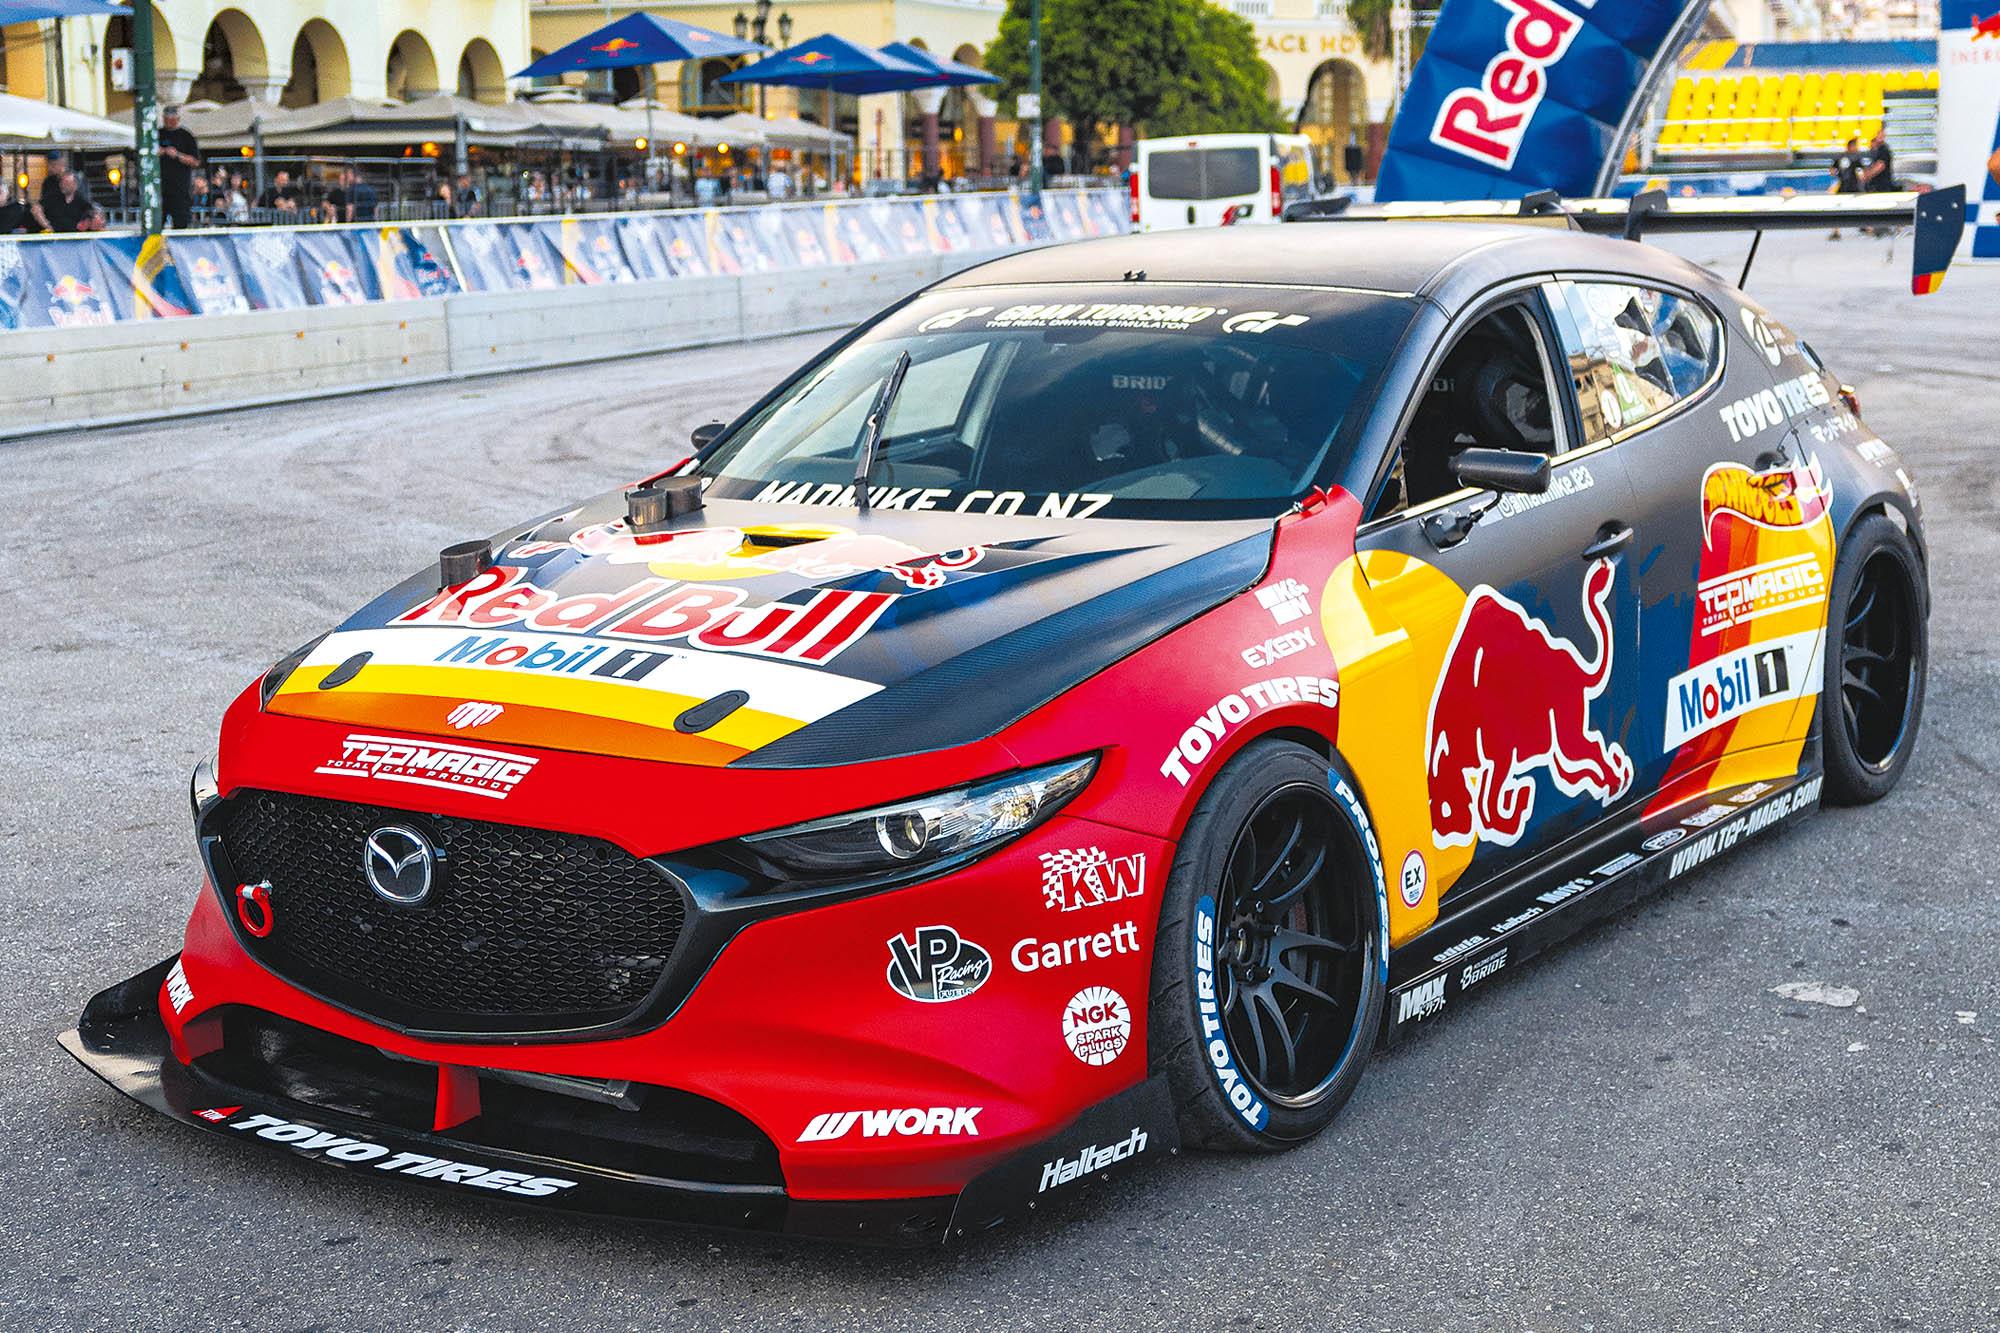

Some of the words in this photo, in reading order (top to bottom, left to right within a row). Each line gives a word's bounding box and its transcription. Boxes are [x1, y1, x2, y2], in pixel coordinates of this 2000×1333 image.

[1434, 0, 1578, 166] Red
[986, 320, 1010, 328] THE
[1012, 319, 1047, 328] REAL
[1049, 319, 1105, 328] DRIVING
[1107, 319, 1190, 330] SIMULATOR
[994, 304, 1085, 321] GRAN
[1719, 388, 1785, 443] TOYO
[1773, 372, 1831, 417] TIRES
[396, 566, 665, 628] Red
[610, 589, 892, 660] Bull
[433, 635, 610, 673] Mobil
[1240, 626, 1317, 669] EXEDY
[1678, 657, 1751, 732] Mobil
[1159, 694, 1251, 787] TOYO
[1240, 676, 1340, 709] TIRES
[326, 759, 369, 770] TOTAL
[382, 765, 417, 775] CAR
[1669, 776, 1823, 880] WWW.TCP-MAGIC.COM
[1061, 853, 1146, 912] KW
[1405, 865, 1421, 889] EX
[887, 925, 961, 1000] VP
[1010, 921, 1141, 973] Garrett
[1471, 954, 1508, 984] BRIDE
[937, 959, 988, 990] Racing
[1195, 910, 1220, 1040] TIRES
[1071, 1001, 1120, 1027] NGK
[1077, 1025, 1122, 1045] SPARK
[1079, 1037, 1123, 1058] PLUGS
[1209, 1038, 1263, 1128] TOYO
[862, 1107, 983, 1137] WORK
[228, 1113, 390, 1162] TOYO
[373, 1151, 579, 1197] TIRES
[1038, 1127, 1149, 1193] Haltech
